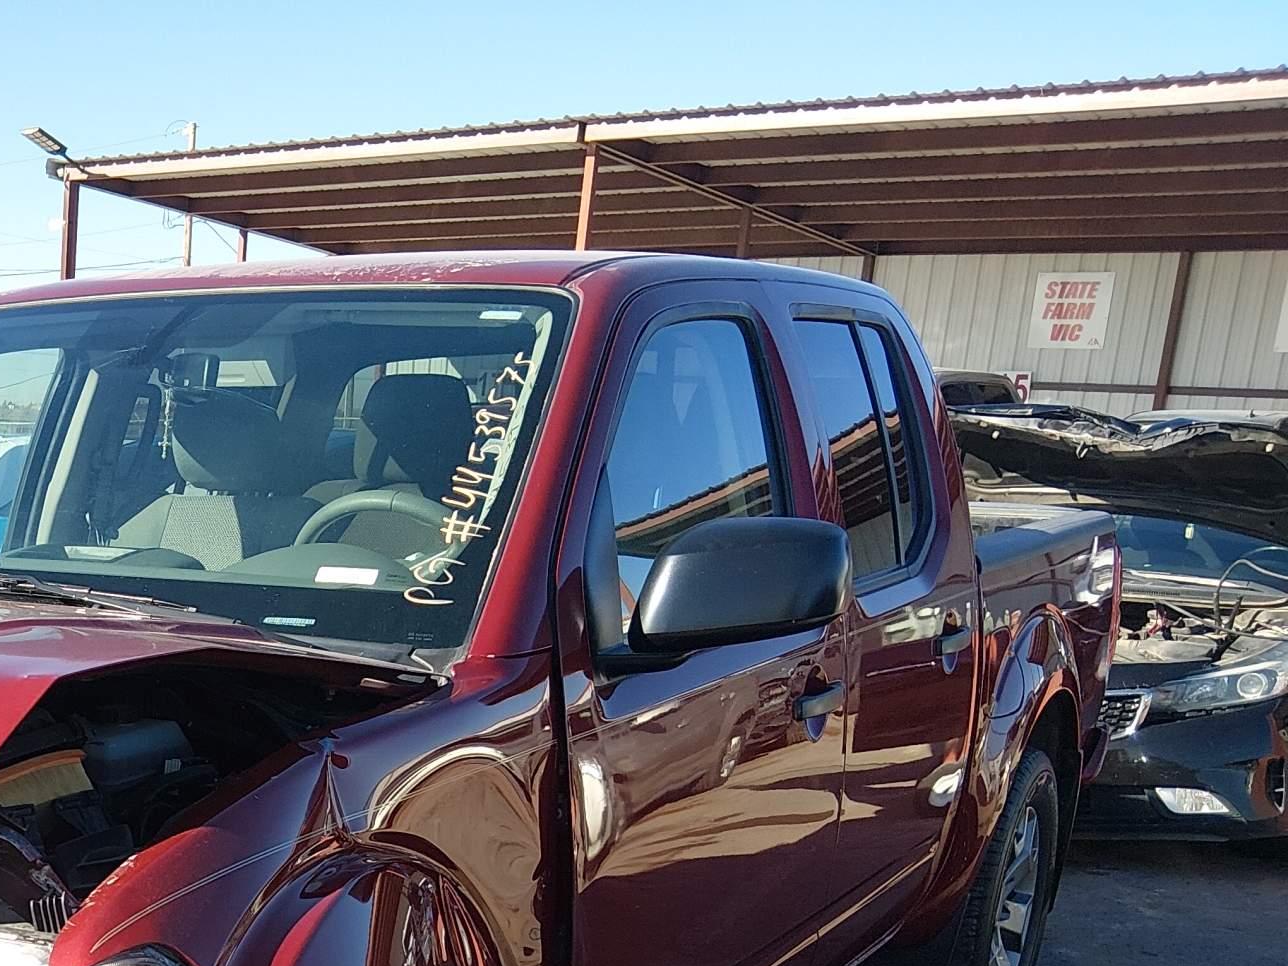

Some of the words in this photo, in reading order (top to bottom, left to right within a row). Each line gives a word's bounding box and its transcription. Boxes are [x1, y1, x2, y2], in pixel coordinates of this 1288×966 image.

[1044, 280, 1102, 299] STATE
[1041, 302, 1096, 320] FARM
[1050, 323, 1083, 341] VIC
